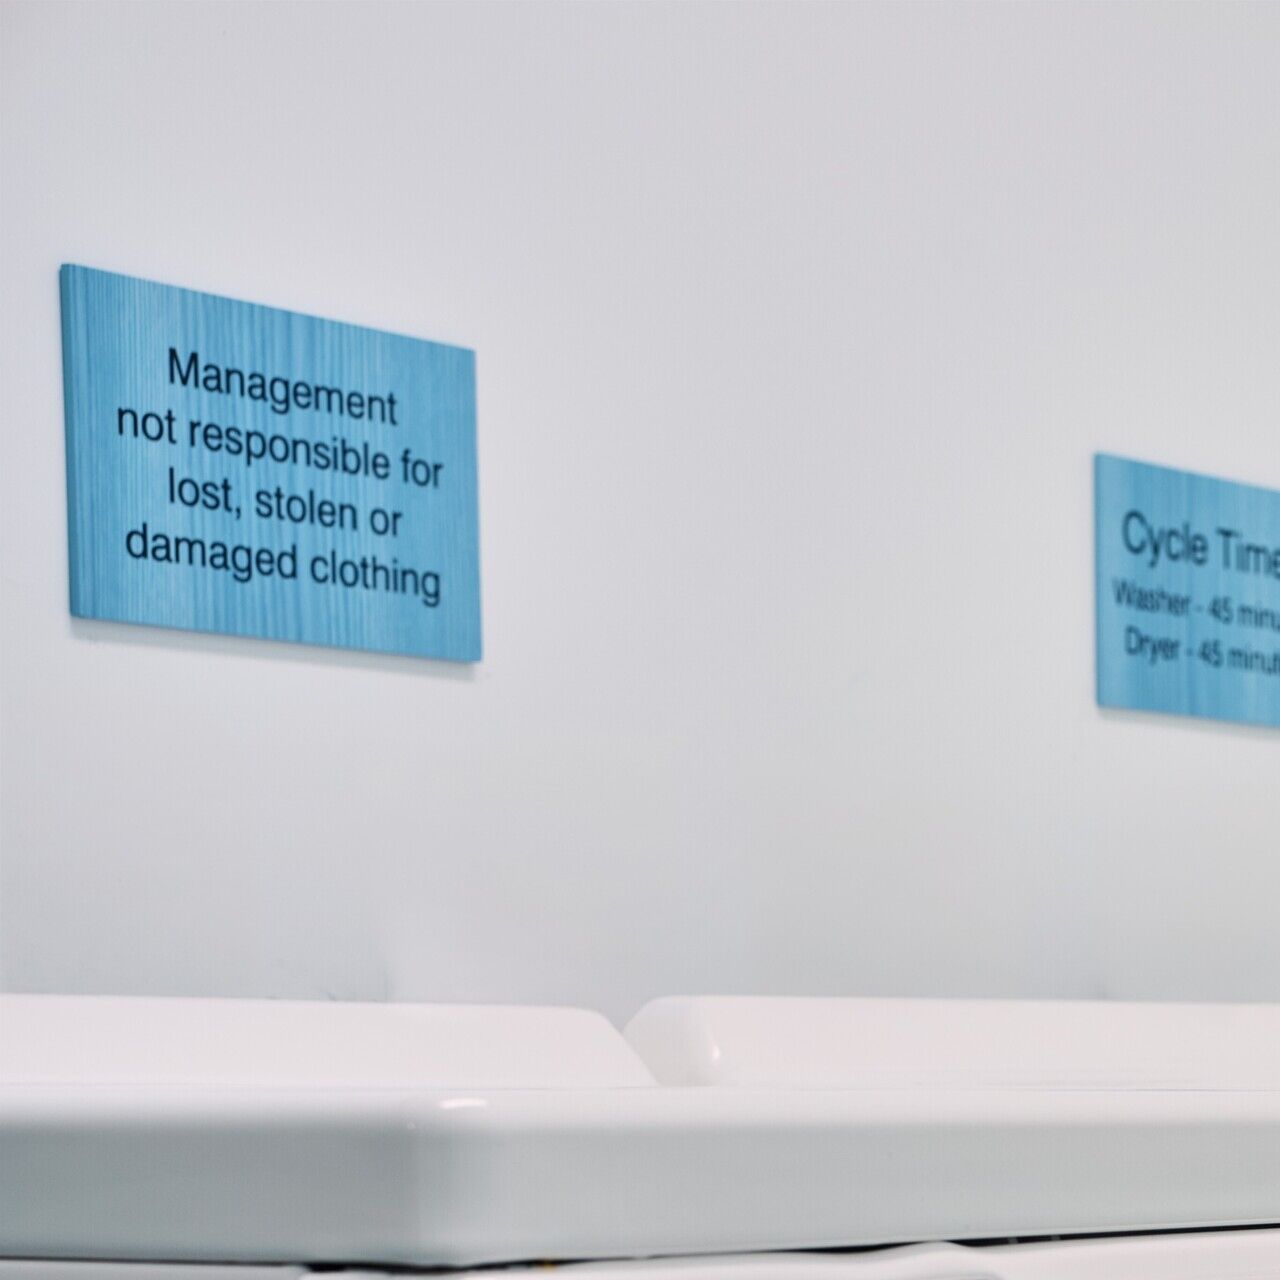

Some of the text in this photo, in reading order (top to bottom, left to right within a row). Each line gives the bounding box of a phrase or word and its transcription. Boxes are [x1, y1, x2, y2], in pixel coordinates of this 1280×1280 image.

[168, 347, 398, 426] Management
[117, 406, 444, 488] not responsible for
[168, 466, 403, 537] lost, stolen or
[125, 522, 441, 607] damaged clothing
[1122, 510, 1208, 569] Cycle
[1112, 578, 1190, 616] Washer
[1208, 597, 1233, 625] 45
[1125, 625, 1180, 666] Dryer
[1198, 639, 1222, 669] 45
